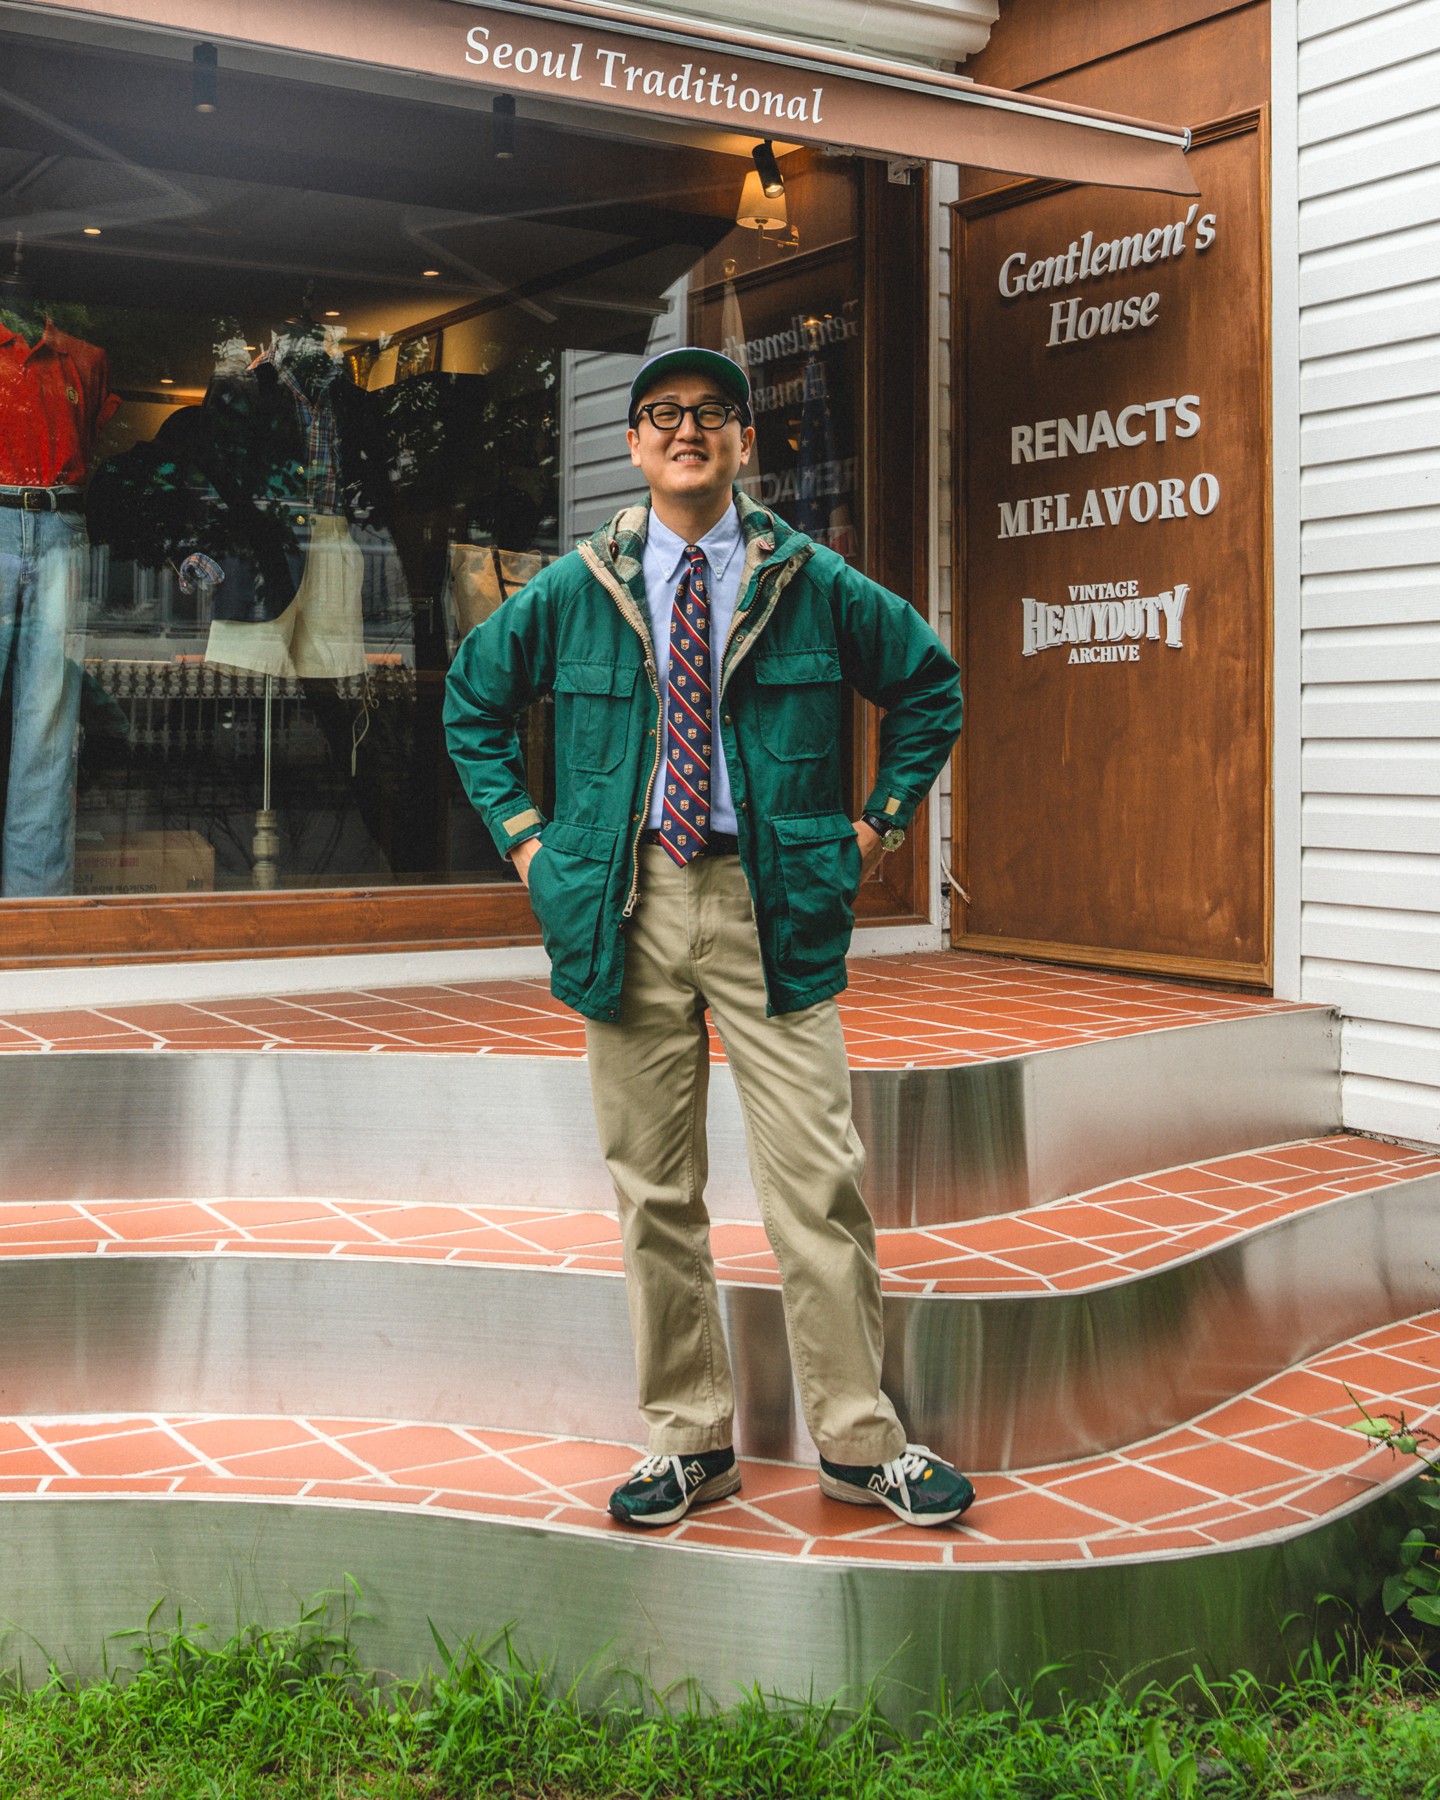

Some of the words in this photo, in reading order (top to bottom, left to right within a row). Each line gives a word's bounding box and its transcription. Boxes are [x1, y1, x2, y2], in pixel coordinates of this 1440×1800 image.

[465, 26, 584, 82] Seoul
[596, 48, 824, 124] Traditional
[998, 203, 1217, 298] Gentlemen's
[1045, 291, 1160, 347] House
[1011, 394, 1201, 465] RENACTS
[997, 472, 1221, 539] MELAVORO
[1021, 583, 1191, 657] HEAVYDUTY
[1068, 580, 1140, 602] VINTAGE
[1067, 645, 1140, 665] ARCHIVE
[684, 1460, 706, 1486] N
